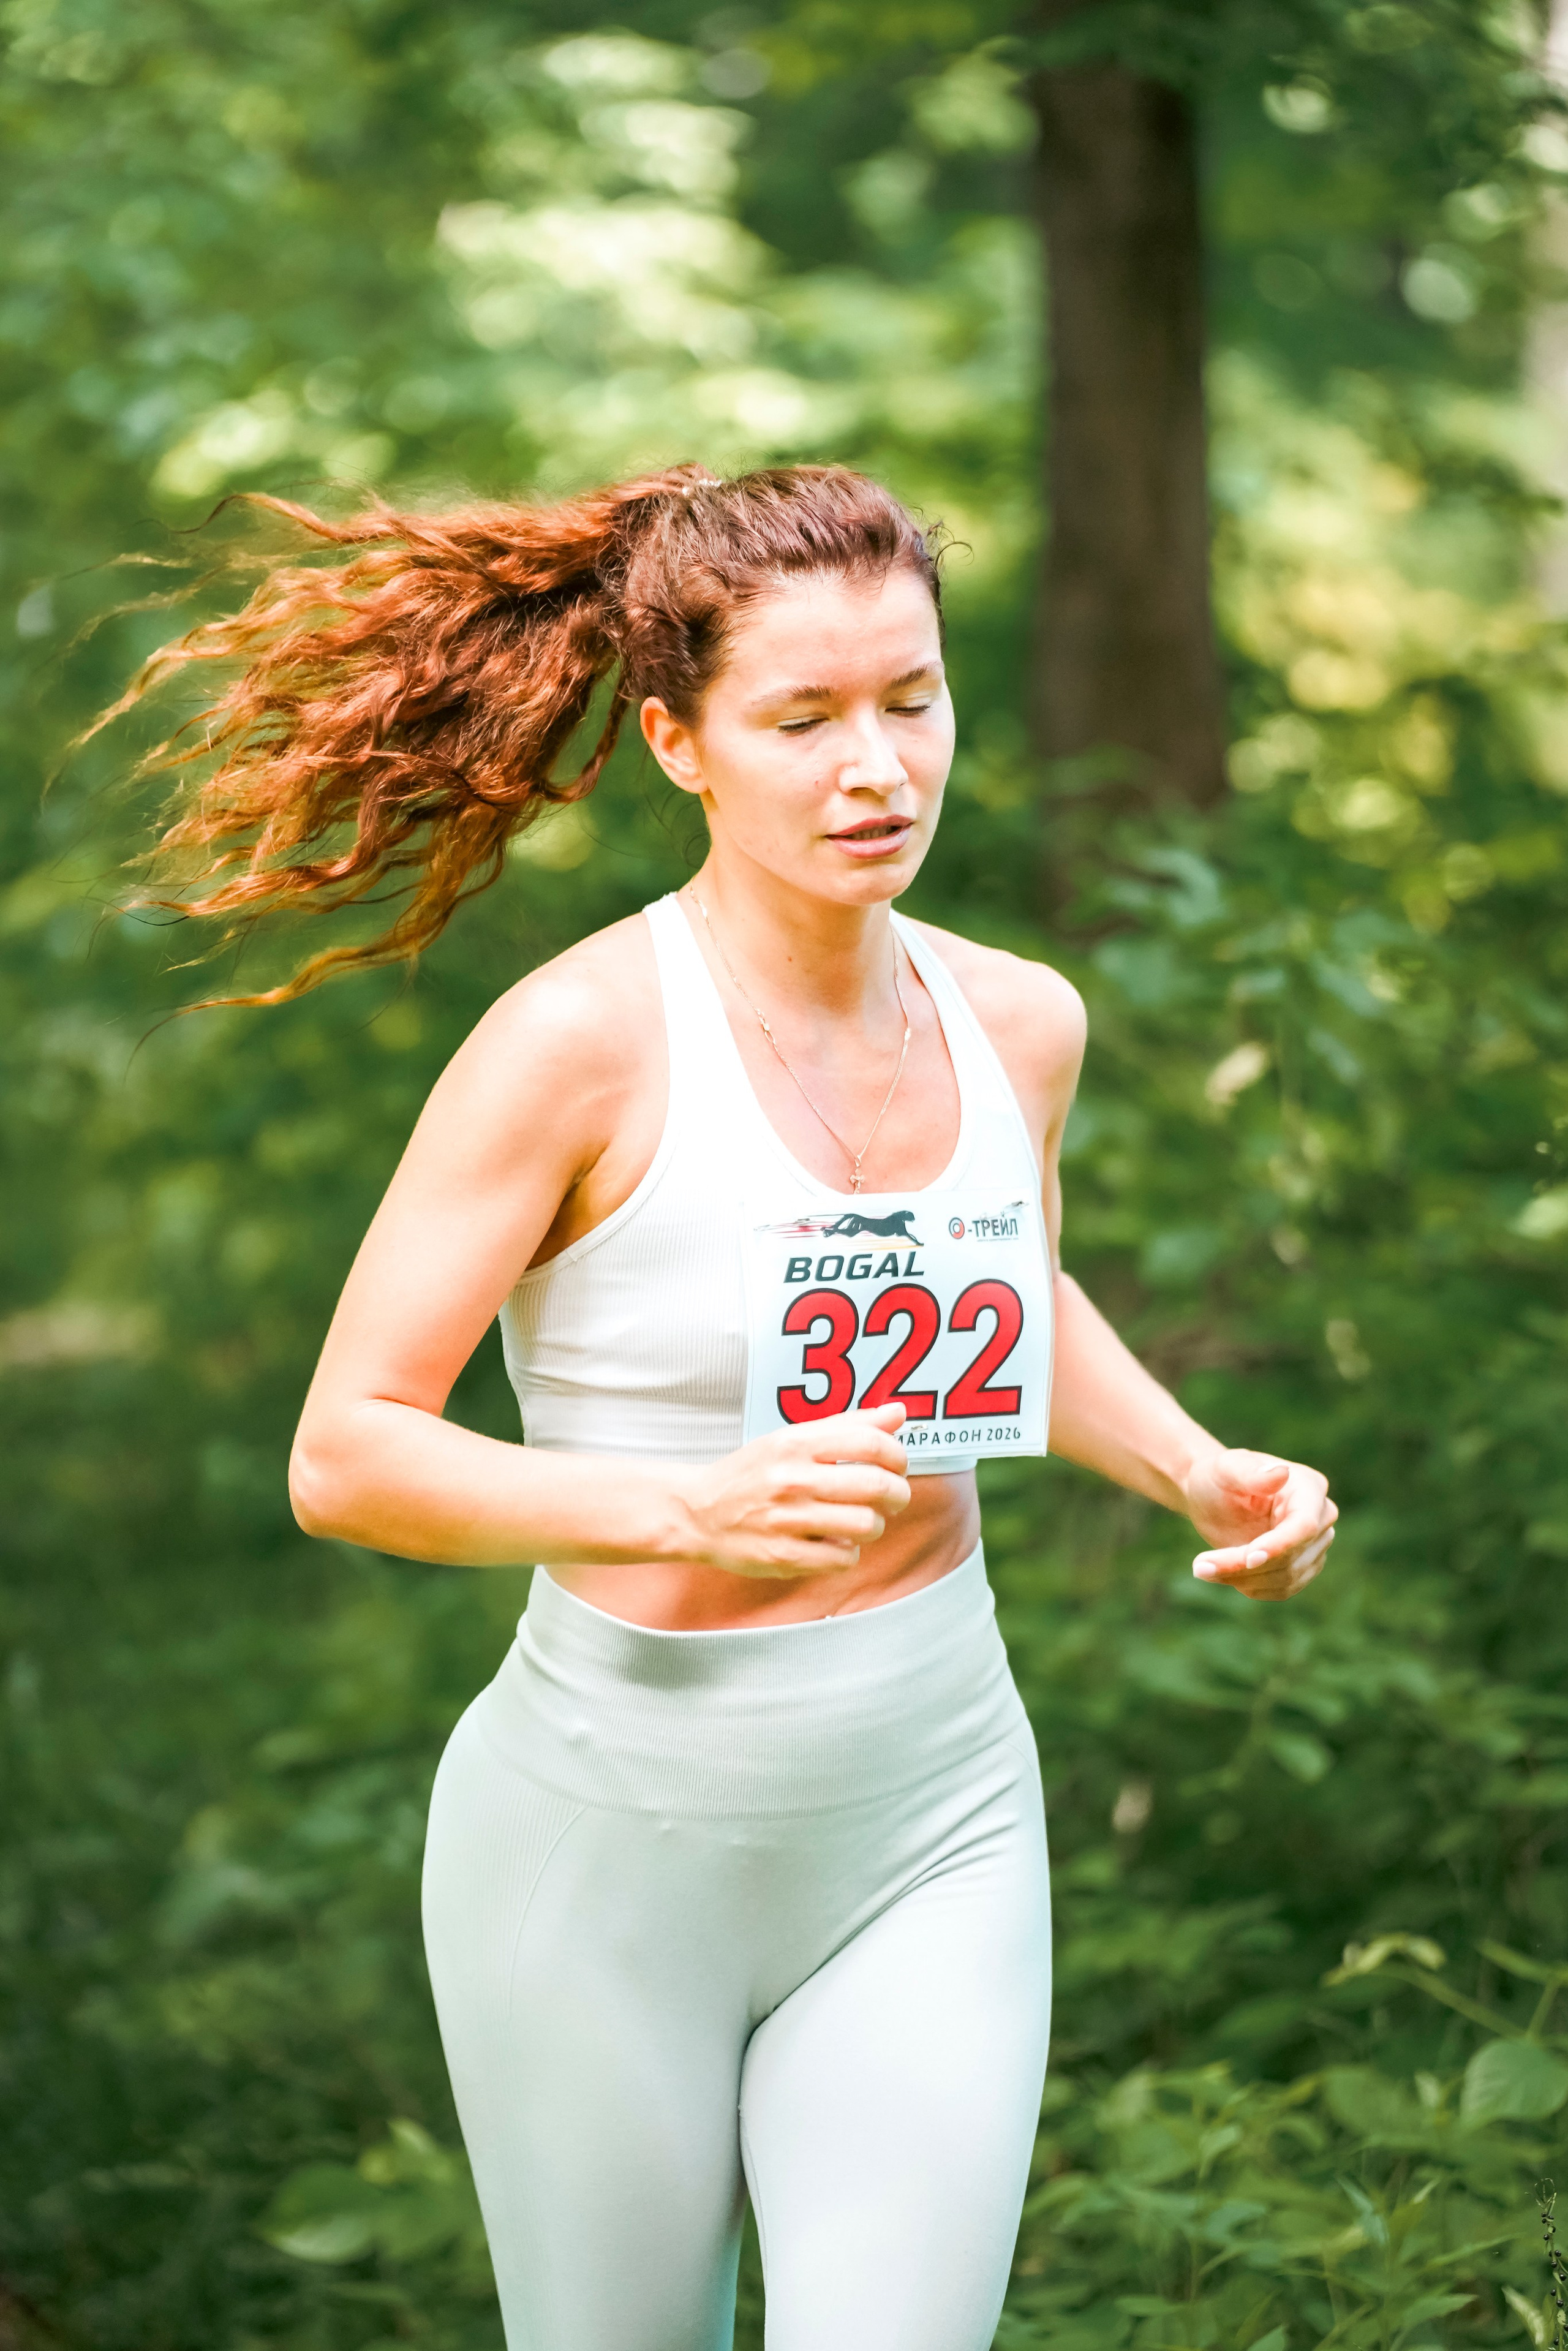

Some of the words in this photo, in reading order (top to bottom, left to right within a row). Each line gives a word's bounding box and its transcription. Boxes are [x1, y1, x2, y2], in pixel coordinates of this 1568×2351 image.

[783, 1251, 925, 1283] BOGAL
[776, 1278, 1024, 1425] 322
[987, 1427, 1021, 1441] 2026
